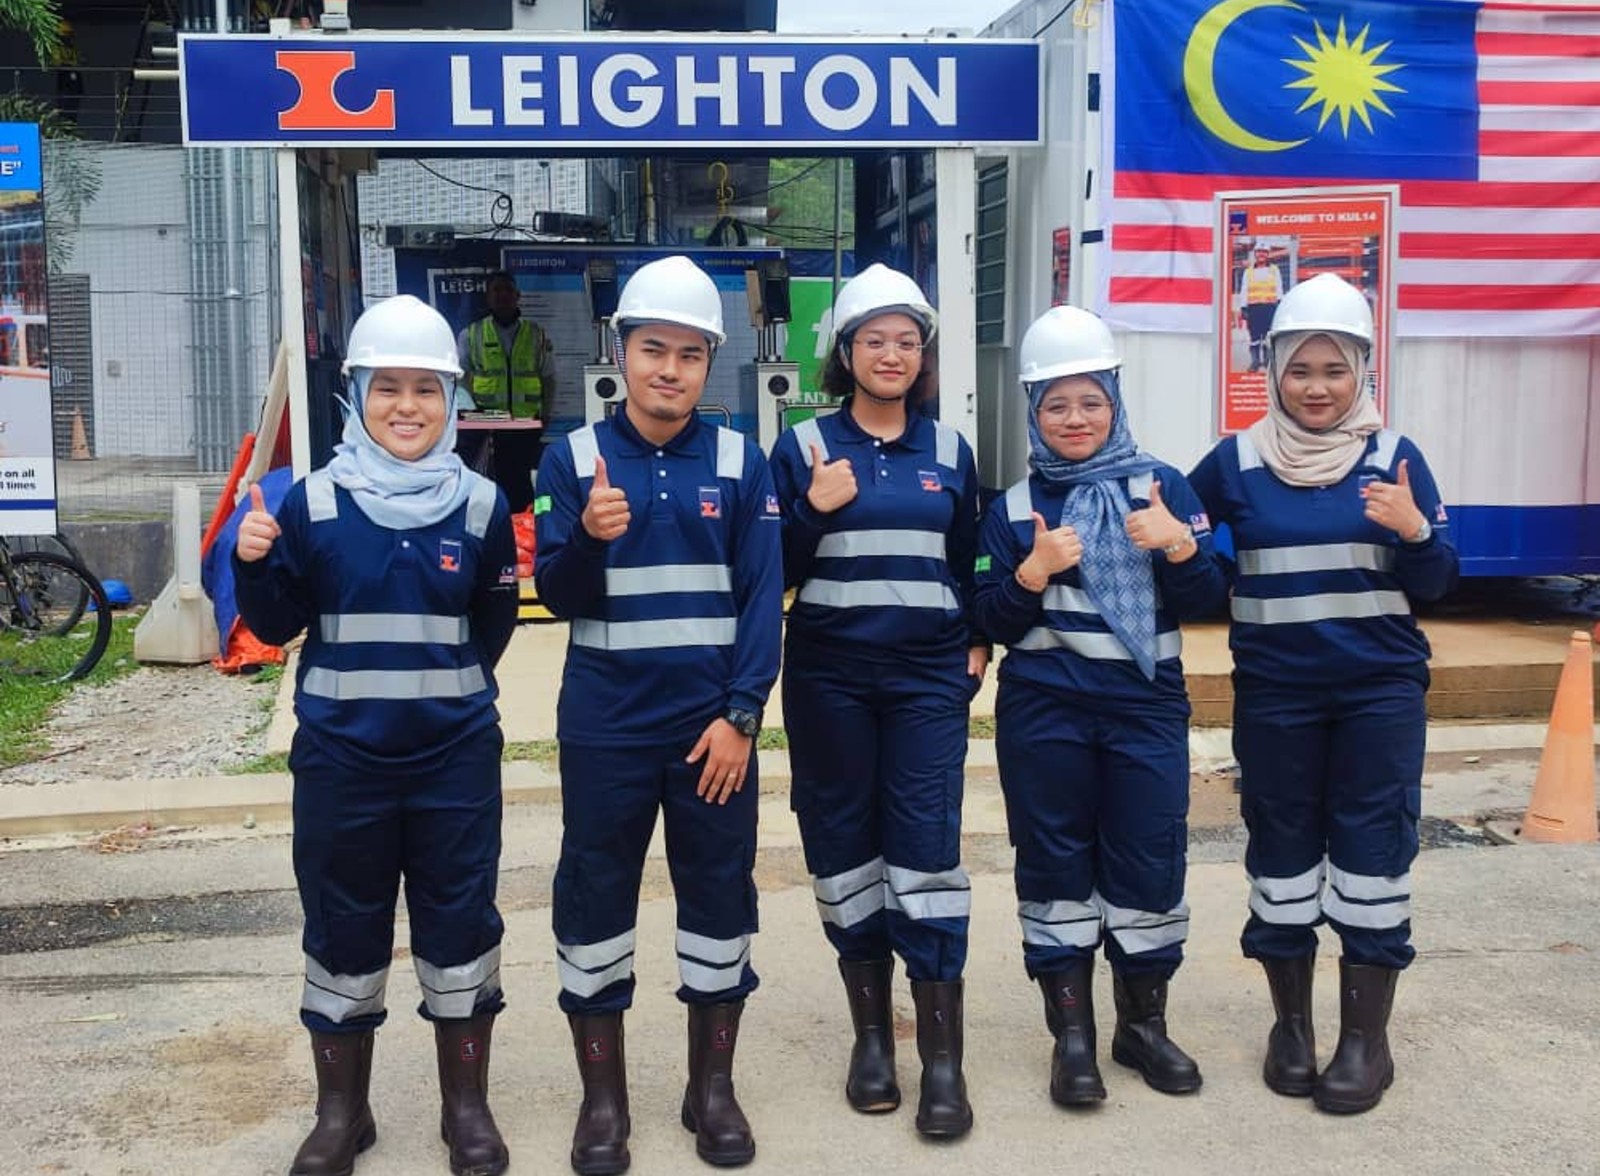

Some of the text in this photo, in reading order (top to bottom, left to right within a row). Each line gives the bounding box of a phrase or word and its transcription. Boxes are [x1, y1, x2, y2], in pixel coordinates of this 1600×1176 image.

[450, 54, 957, 131] LEIGHTON
[1256, 211, 1377, 225] WELCOME TO KUL14
[518, 258, 566, 267] LEIGHTON
[440, 279, 487, 294] LEIGH
[22, 468, 35, 478] all
[7, 482, 37, 491] times
